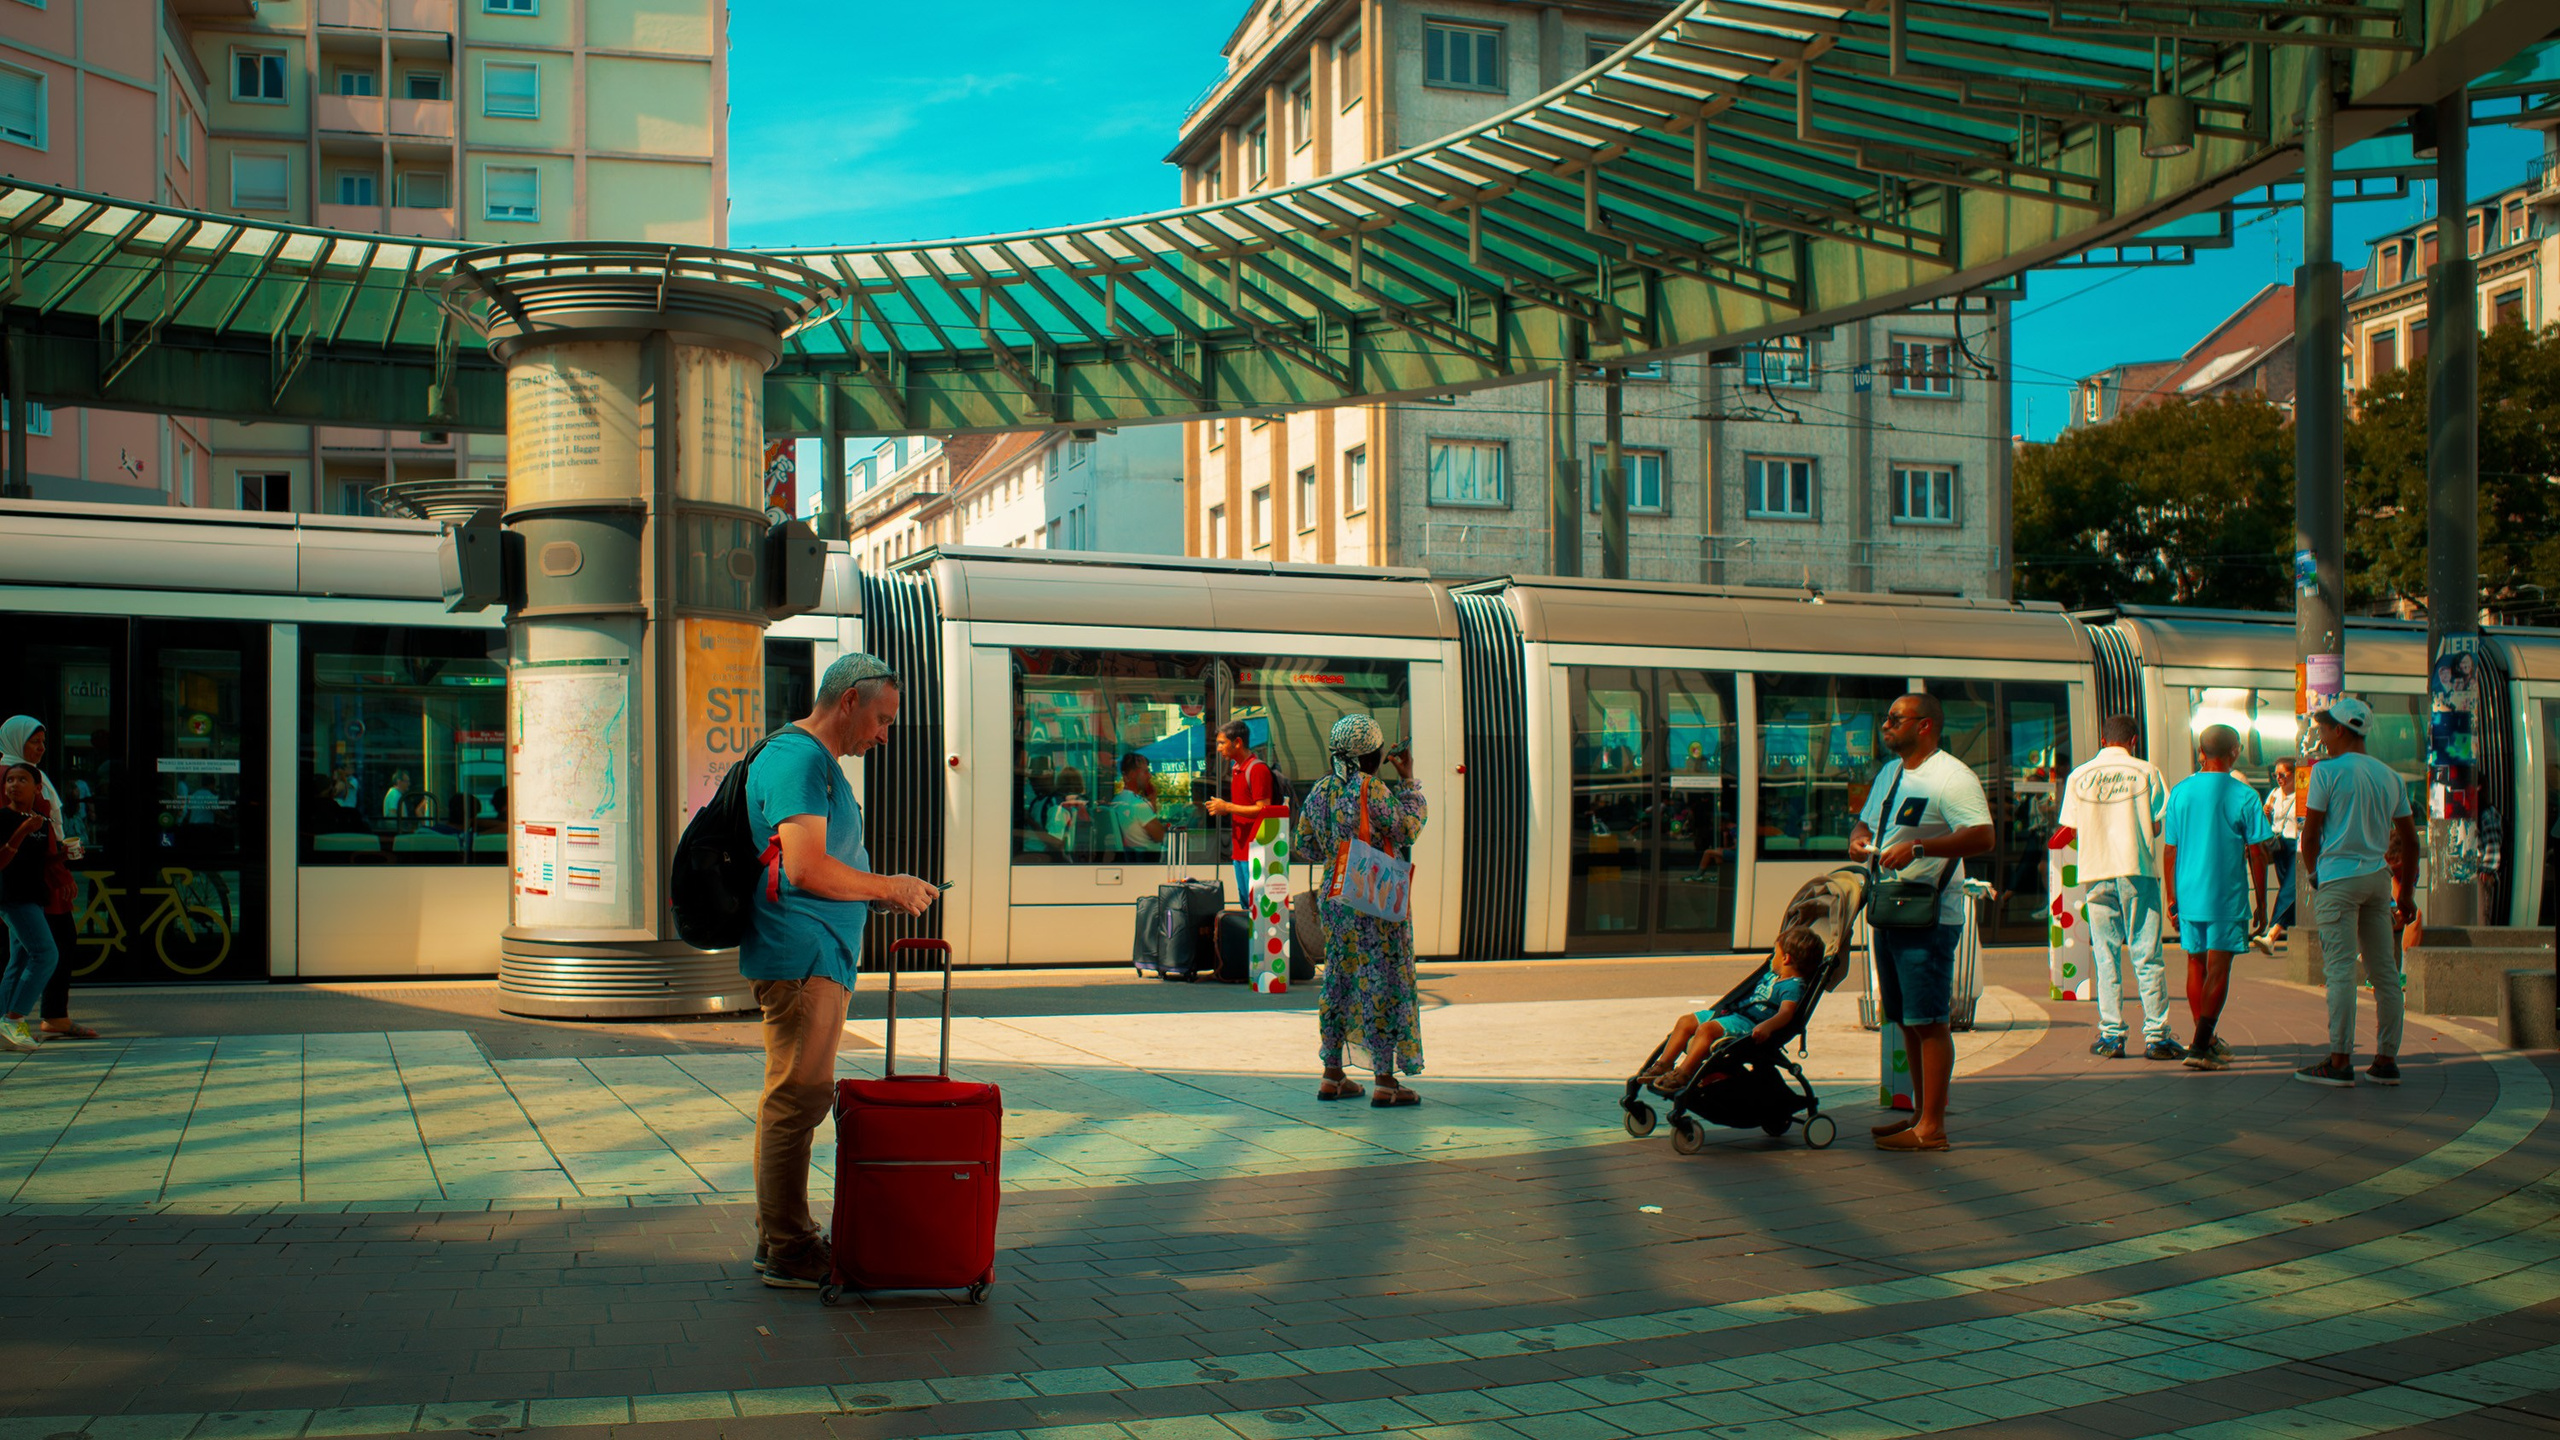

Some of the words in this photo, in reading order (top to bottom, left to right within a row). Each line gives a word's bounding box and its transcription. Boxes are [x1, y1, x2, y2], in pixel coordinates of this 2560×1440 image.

[1854, 369, 1871, 387] 100
[573, 431, 600, 442] record
[702, 775, 711, 787] 7
